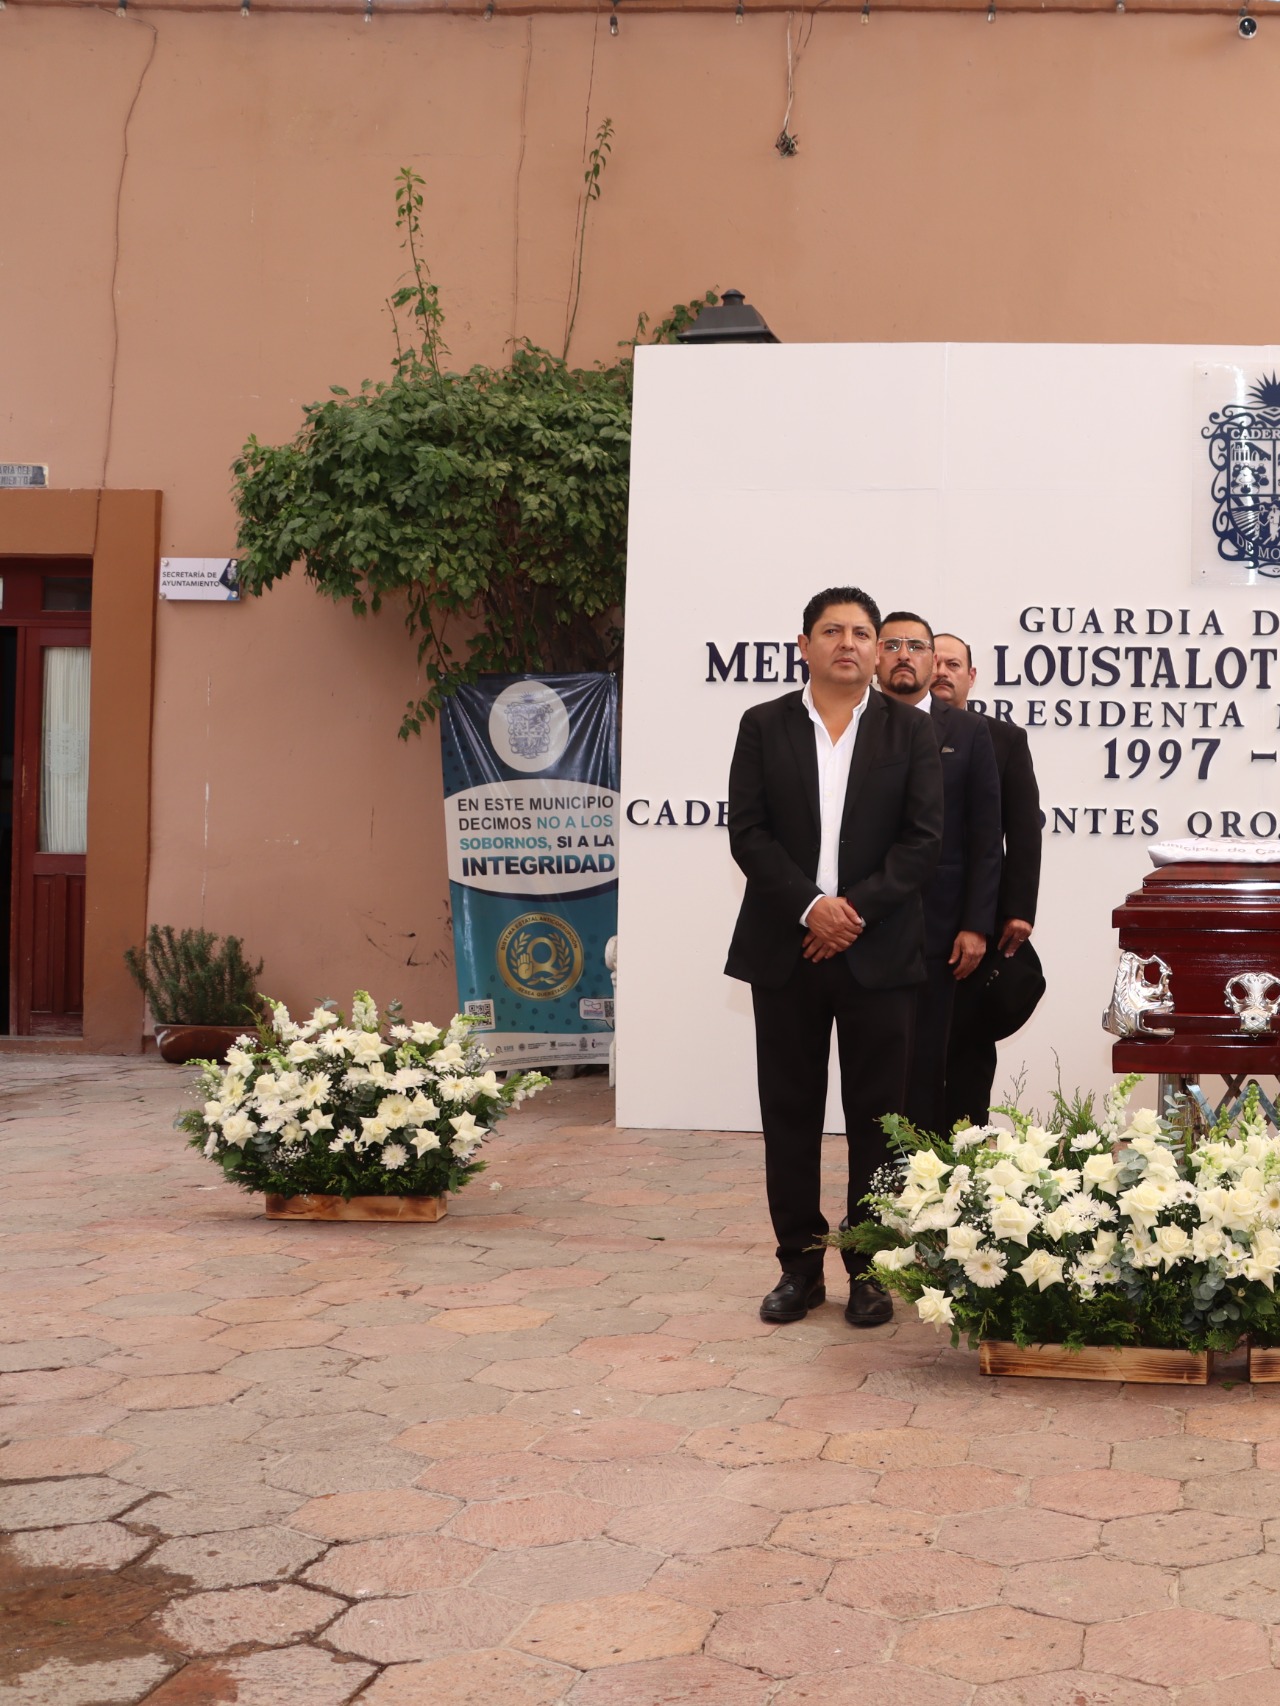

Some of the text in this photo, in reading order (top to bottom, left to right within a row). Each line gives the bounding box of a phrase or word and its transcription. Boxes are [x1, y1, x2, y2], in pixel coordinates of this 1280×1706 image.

[1236, 532, 1254, 554] DE
[162, 570, 205, 578] SECRETARÍA
[1020, 606, 1224, 636] GUARDIA
[705, 641, 809, 684] MER
[994, 644, 1278, 691] LOUSTALOT
[1103, 736, 1223, 781] 1997
[458, 795, 614, 811] EN ESTE MUNICIPIO
[626, 799, 730, 828] CADE
[459, 814, 613, 831] DECIMOS NO A LOS
[459, 834, 614, 851] SOBORNOS, SI A LA
[1158, 842, 1219, 853] unicipio
[462, 854, 615, 876] INTEGRIDAD
